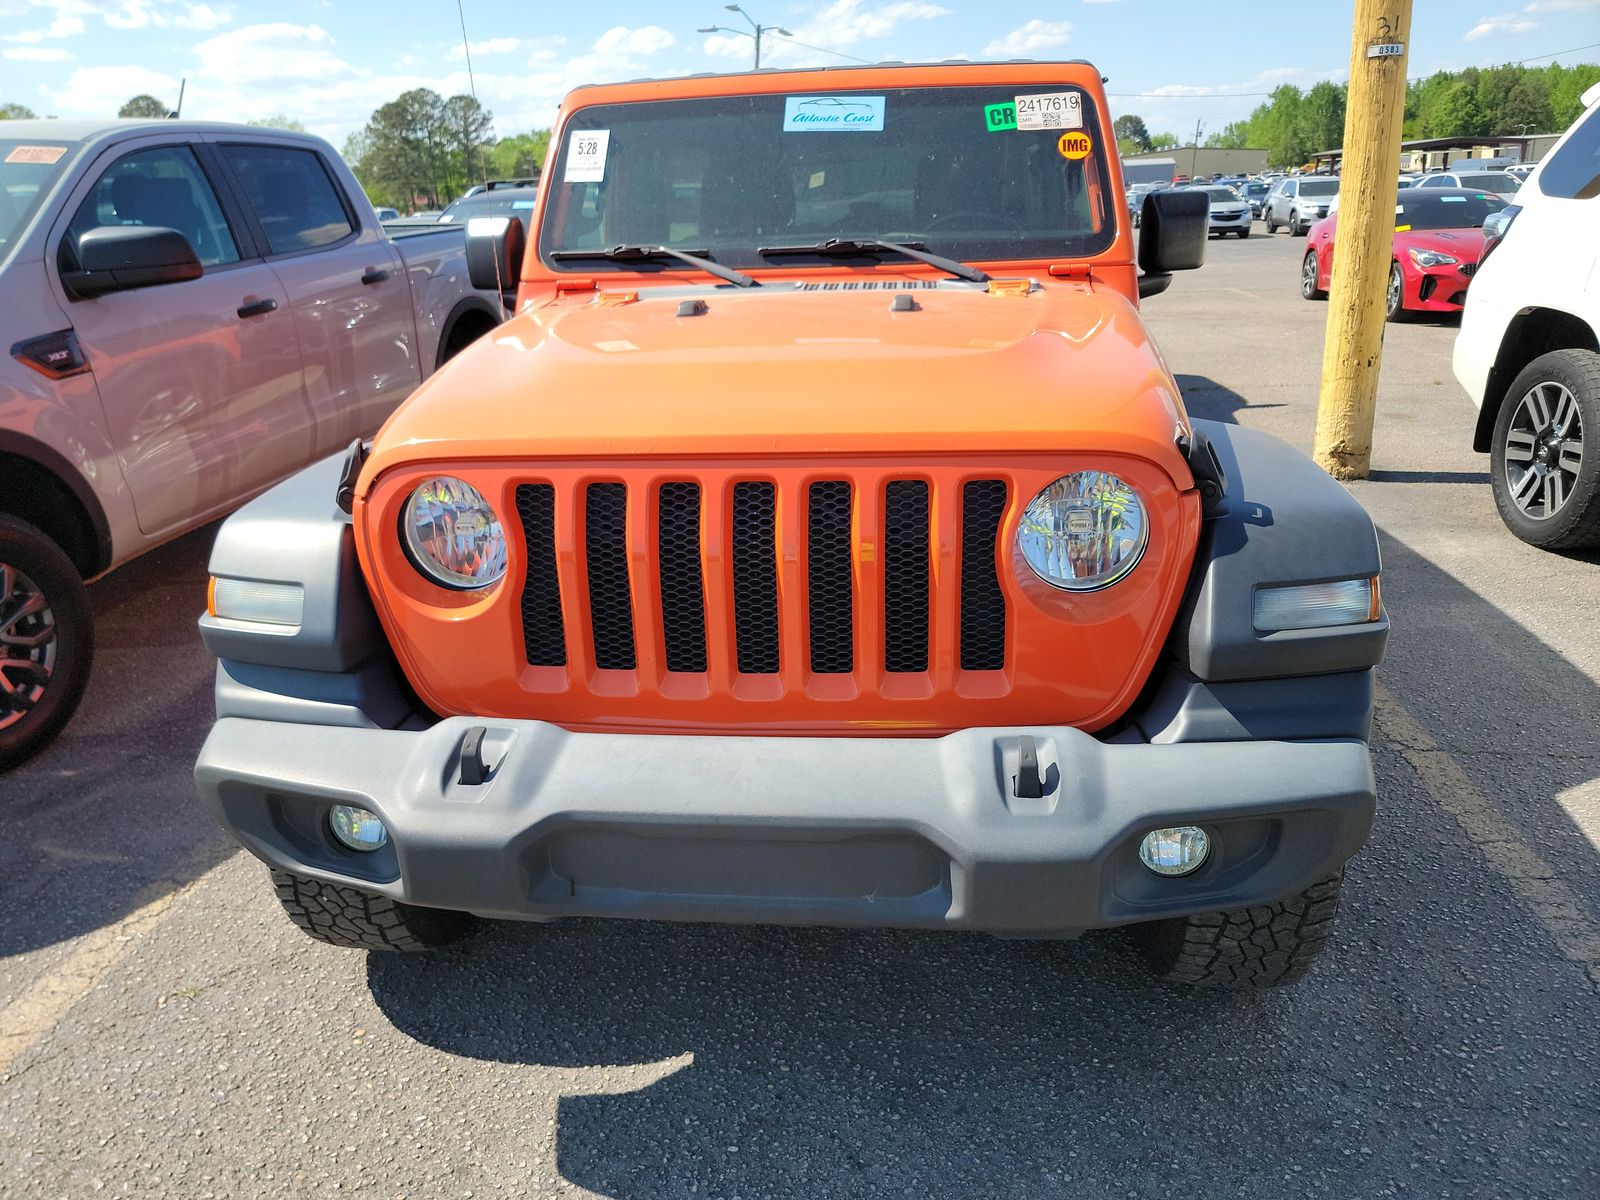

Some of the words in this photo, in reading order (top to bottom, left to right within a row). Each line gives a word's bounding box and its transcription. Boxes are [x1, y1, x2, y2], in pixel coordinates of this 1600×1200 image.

[1376, 15, 1399, 39] 31
[1379, 46, 1400, 54] 0583
[1018, 95, 1079, 113] 2417619
[792, 112, 840, 123] Atlantic
[843, 112, 875, 123] Coast
[989, 107, 1016, 126] CR
[578, 142, 598, 155] 5:28
[1062, 138, 1089, 153] IMG
